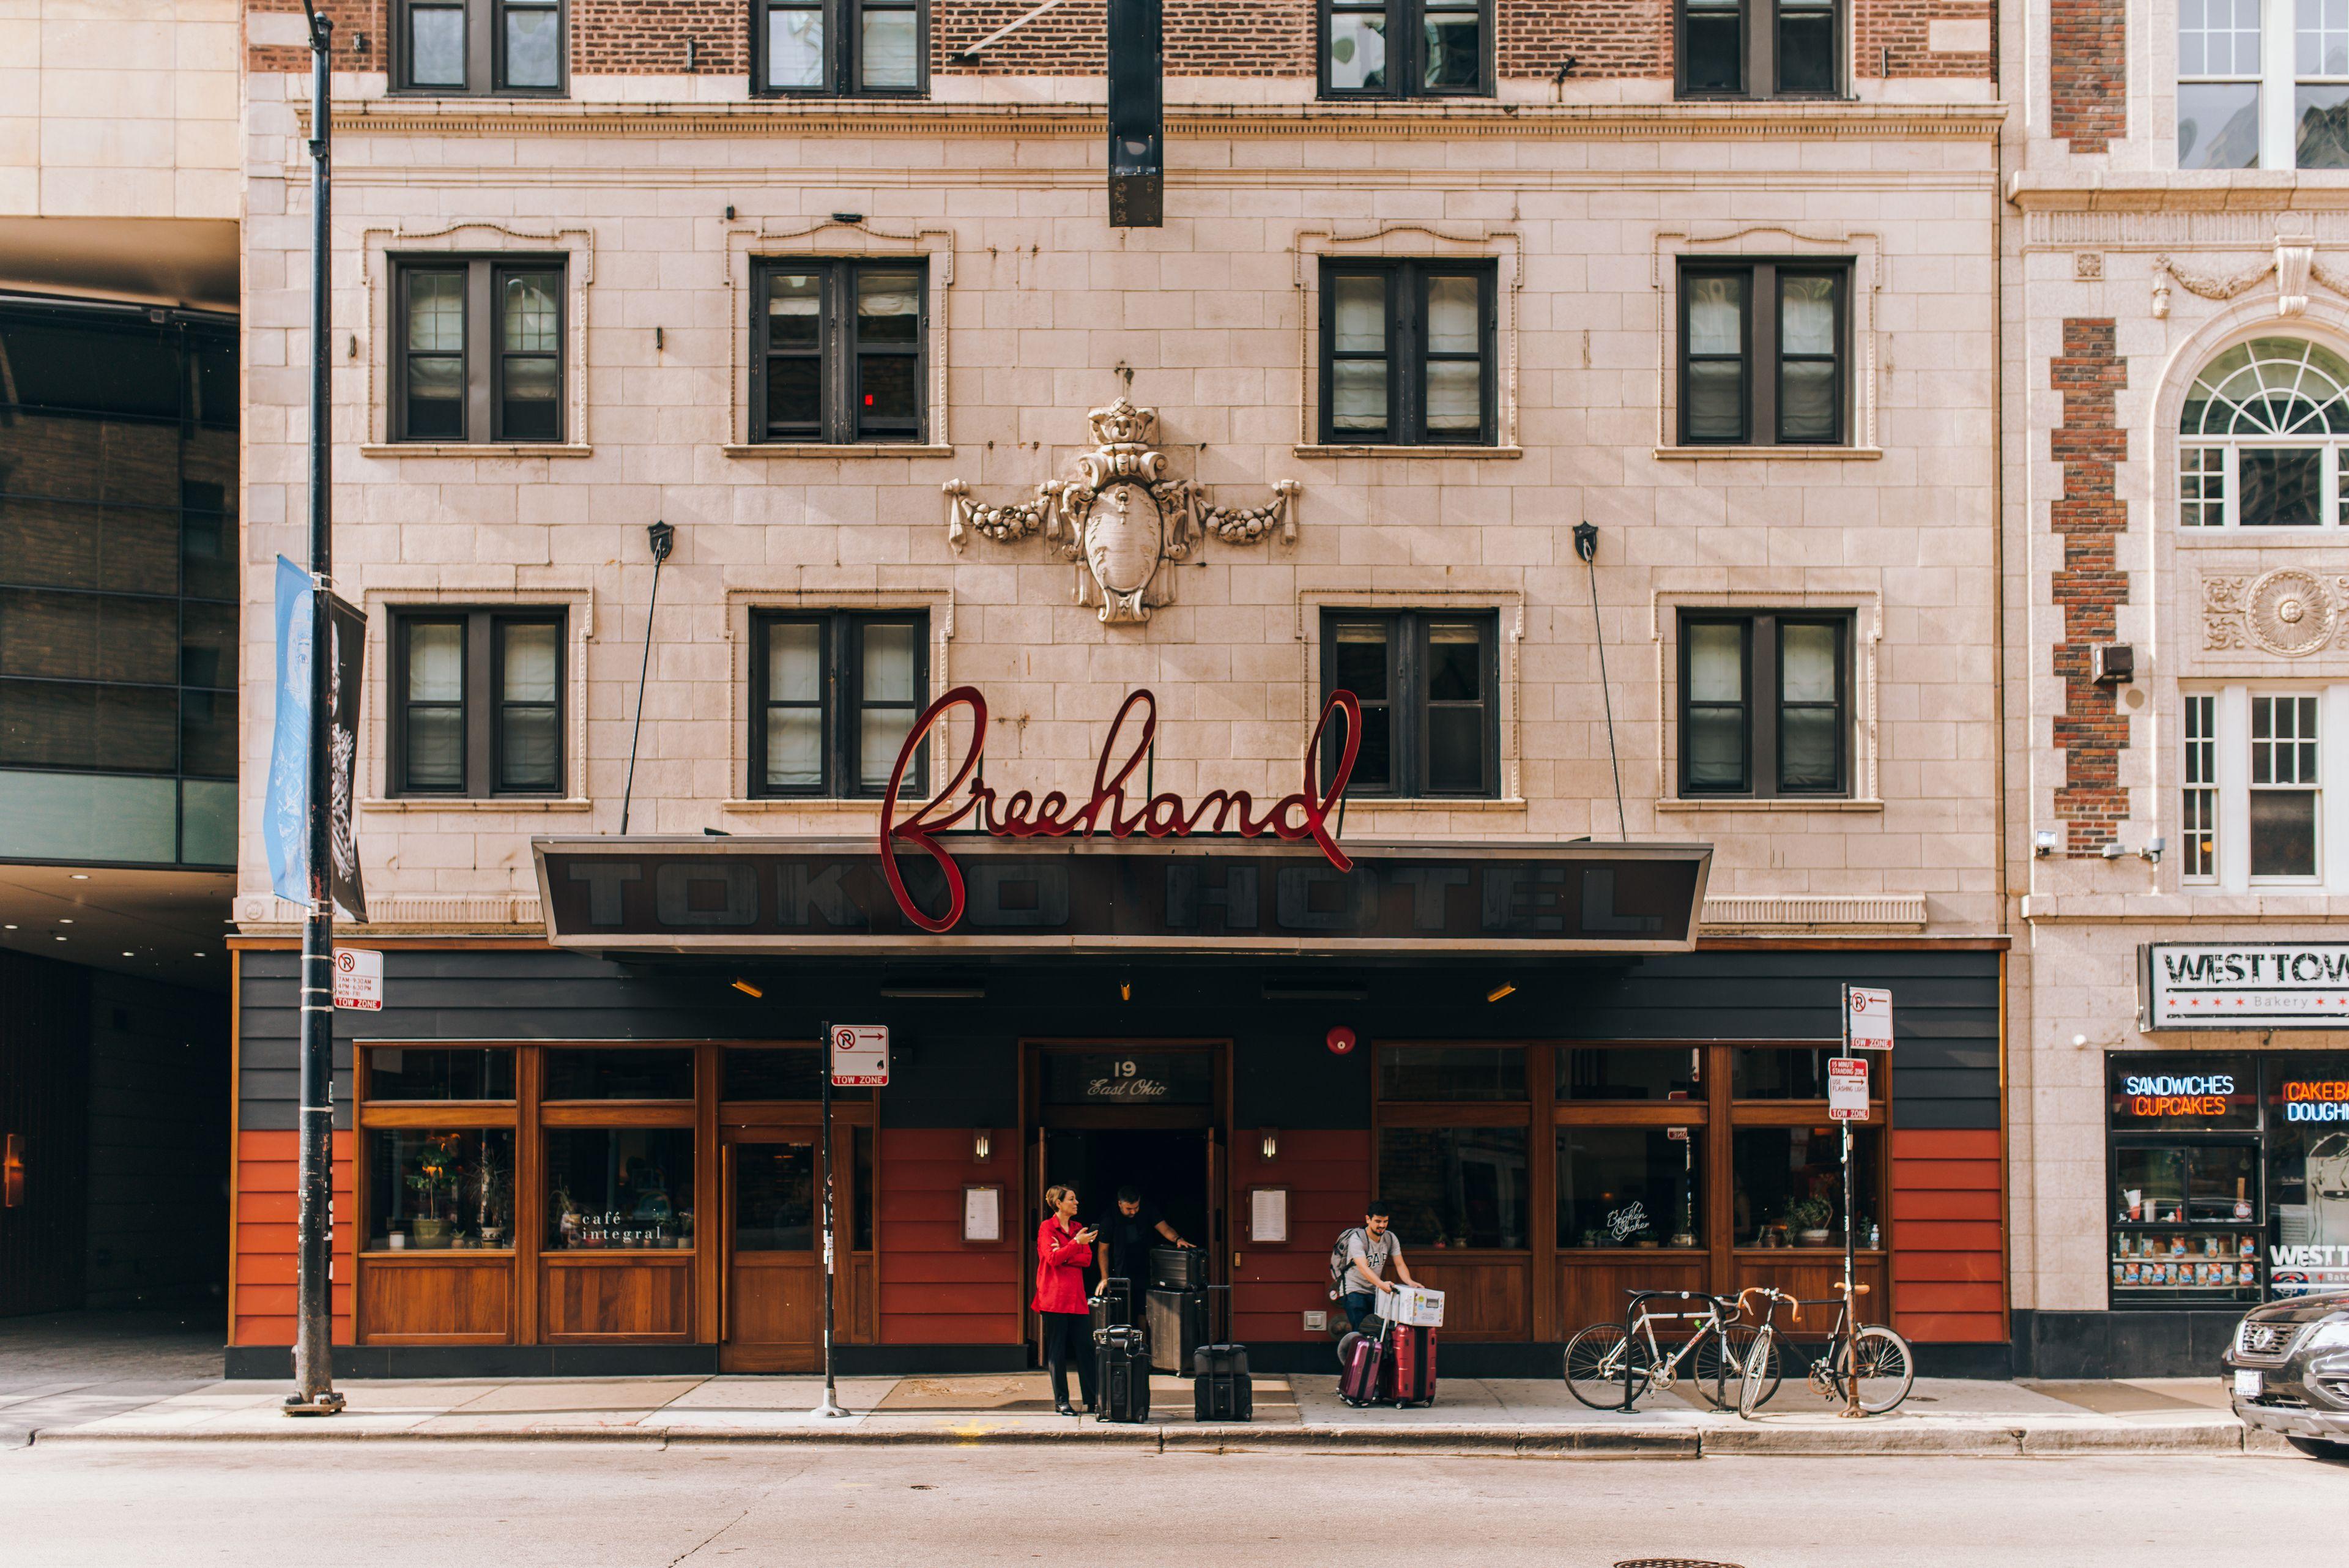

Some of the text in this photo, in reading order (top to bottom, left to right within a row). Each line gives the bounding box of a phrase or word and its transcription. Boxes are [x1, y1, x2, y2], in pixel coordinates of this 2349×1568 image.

[880, 685, 1361, 934] freehand
[568, 863, 1663, 931] TOKYO HOTEL
[2163, 953, 2265, 985] WEST
[338, 998, 377, 1009] TOW ZONE
[2254, 995, 2309, 1009] Bakery
[1869, 1039, 1889, 1047] ZONE
[1115, 1061, 1137, 1077] 19
[1087, 1079, 1168, 1096] East Ohio
[2125, 1076, 2235, 1096] SANDWICHES
[2285, 1082, 2349, 1101] CAKEB
[2134, 1096, 2226, 1117] CUPCAKES
[582, 1211, 621, 1225] café
[1607, 1209, 1648, 1227] Broken
[582, 1226, 661, 1243] integral
[1616, 1219, 1650, 1235] Shaker
[2269, 1244, 2336, 1266] WEST
